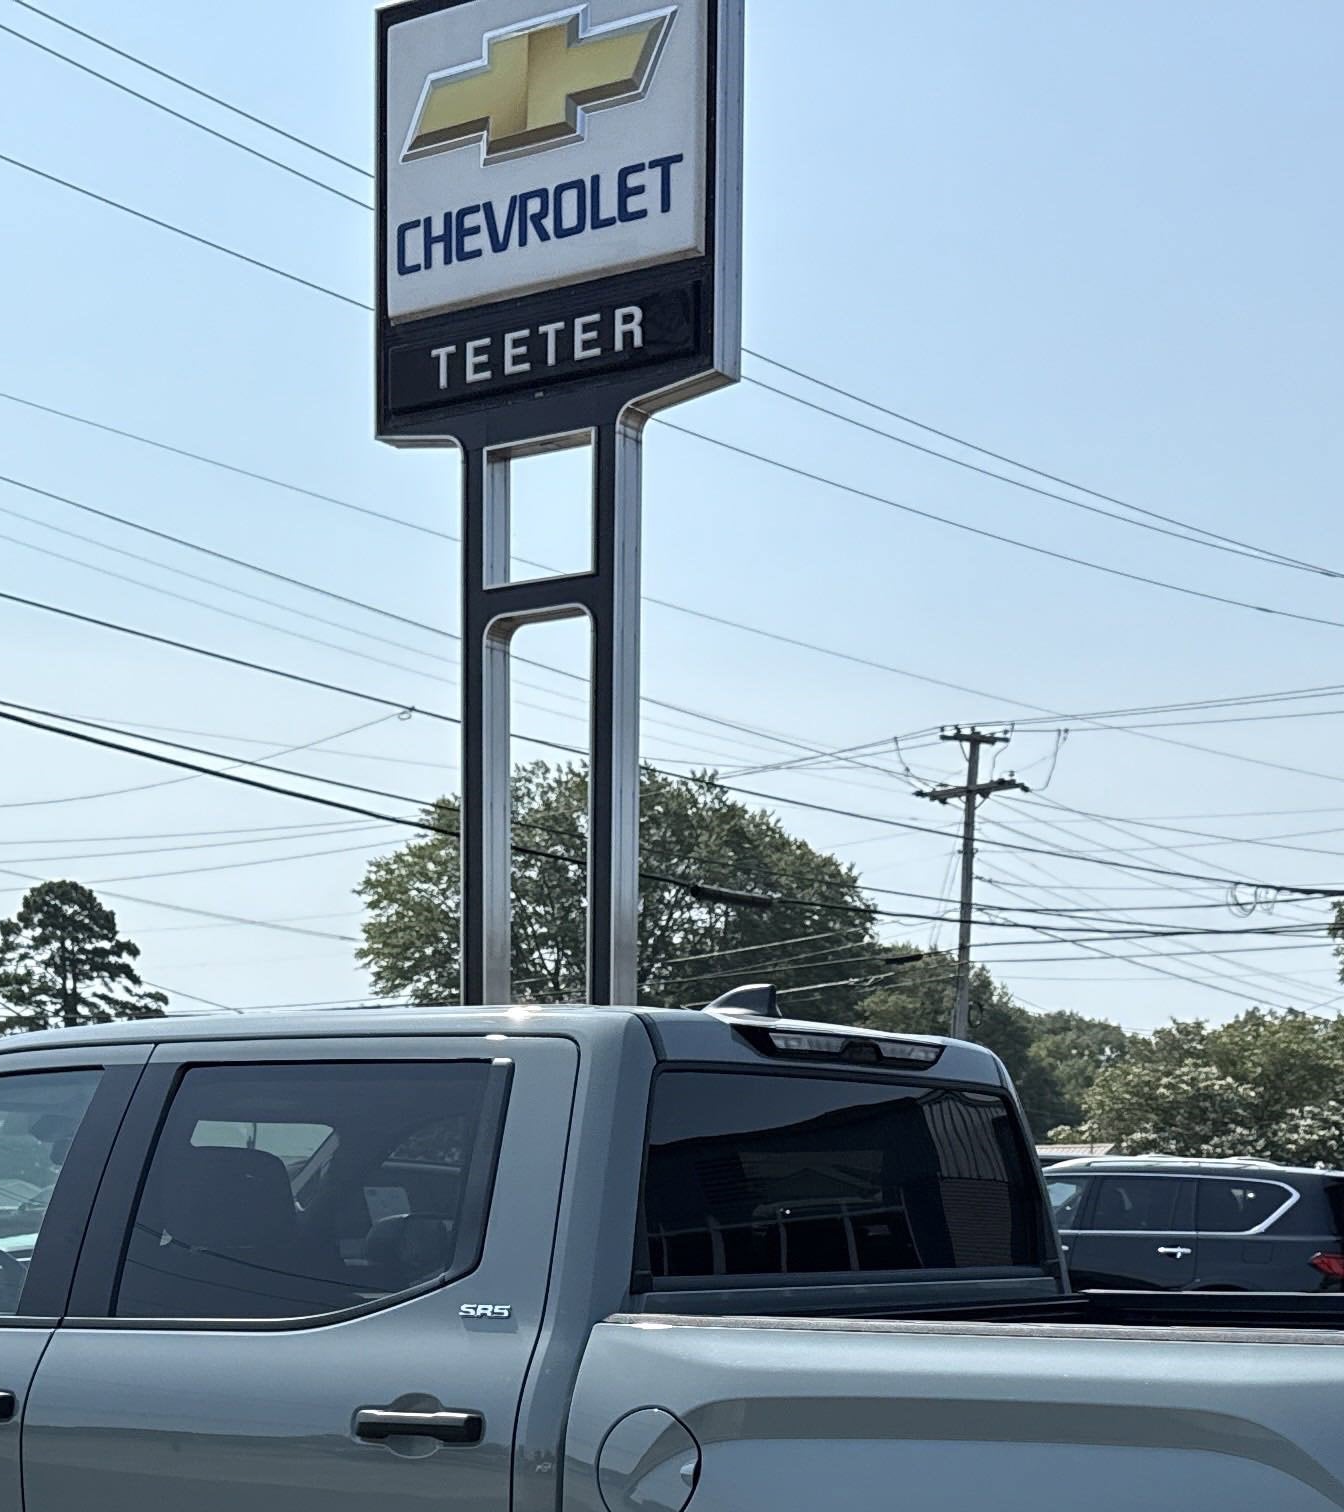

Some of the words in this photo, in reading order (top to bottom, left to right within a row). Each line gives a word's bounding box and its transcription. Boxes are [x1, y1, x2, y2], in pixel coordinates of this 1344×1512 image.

[397, 153, 683, 276] CHEVROLET
[430, 305, 644, 389] TEETER
[458, 1303, 512, 1319] SR5
